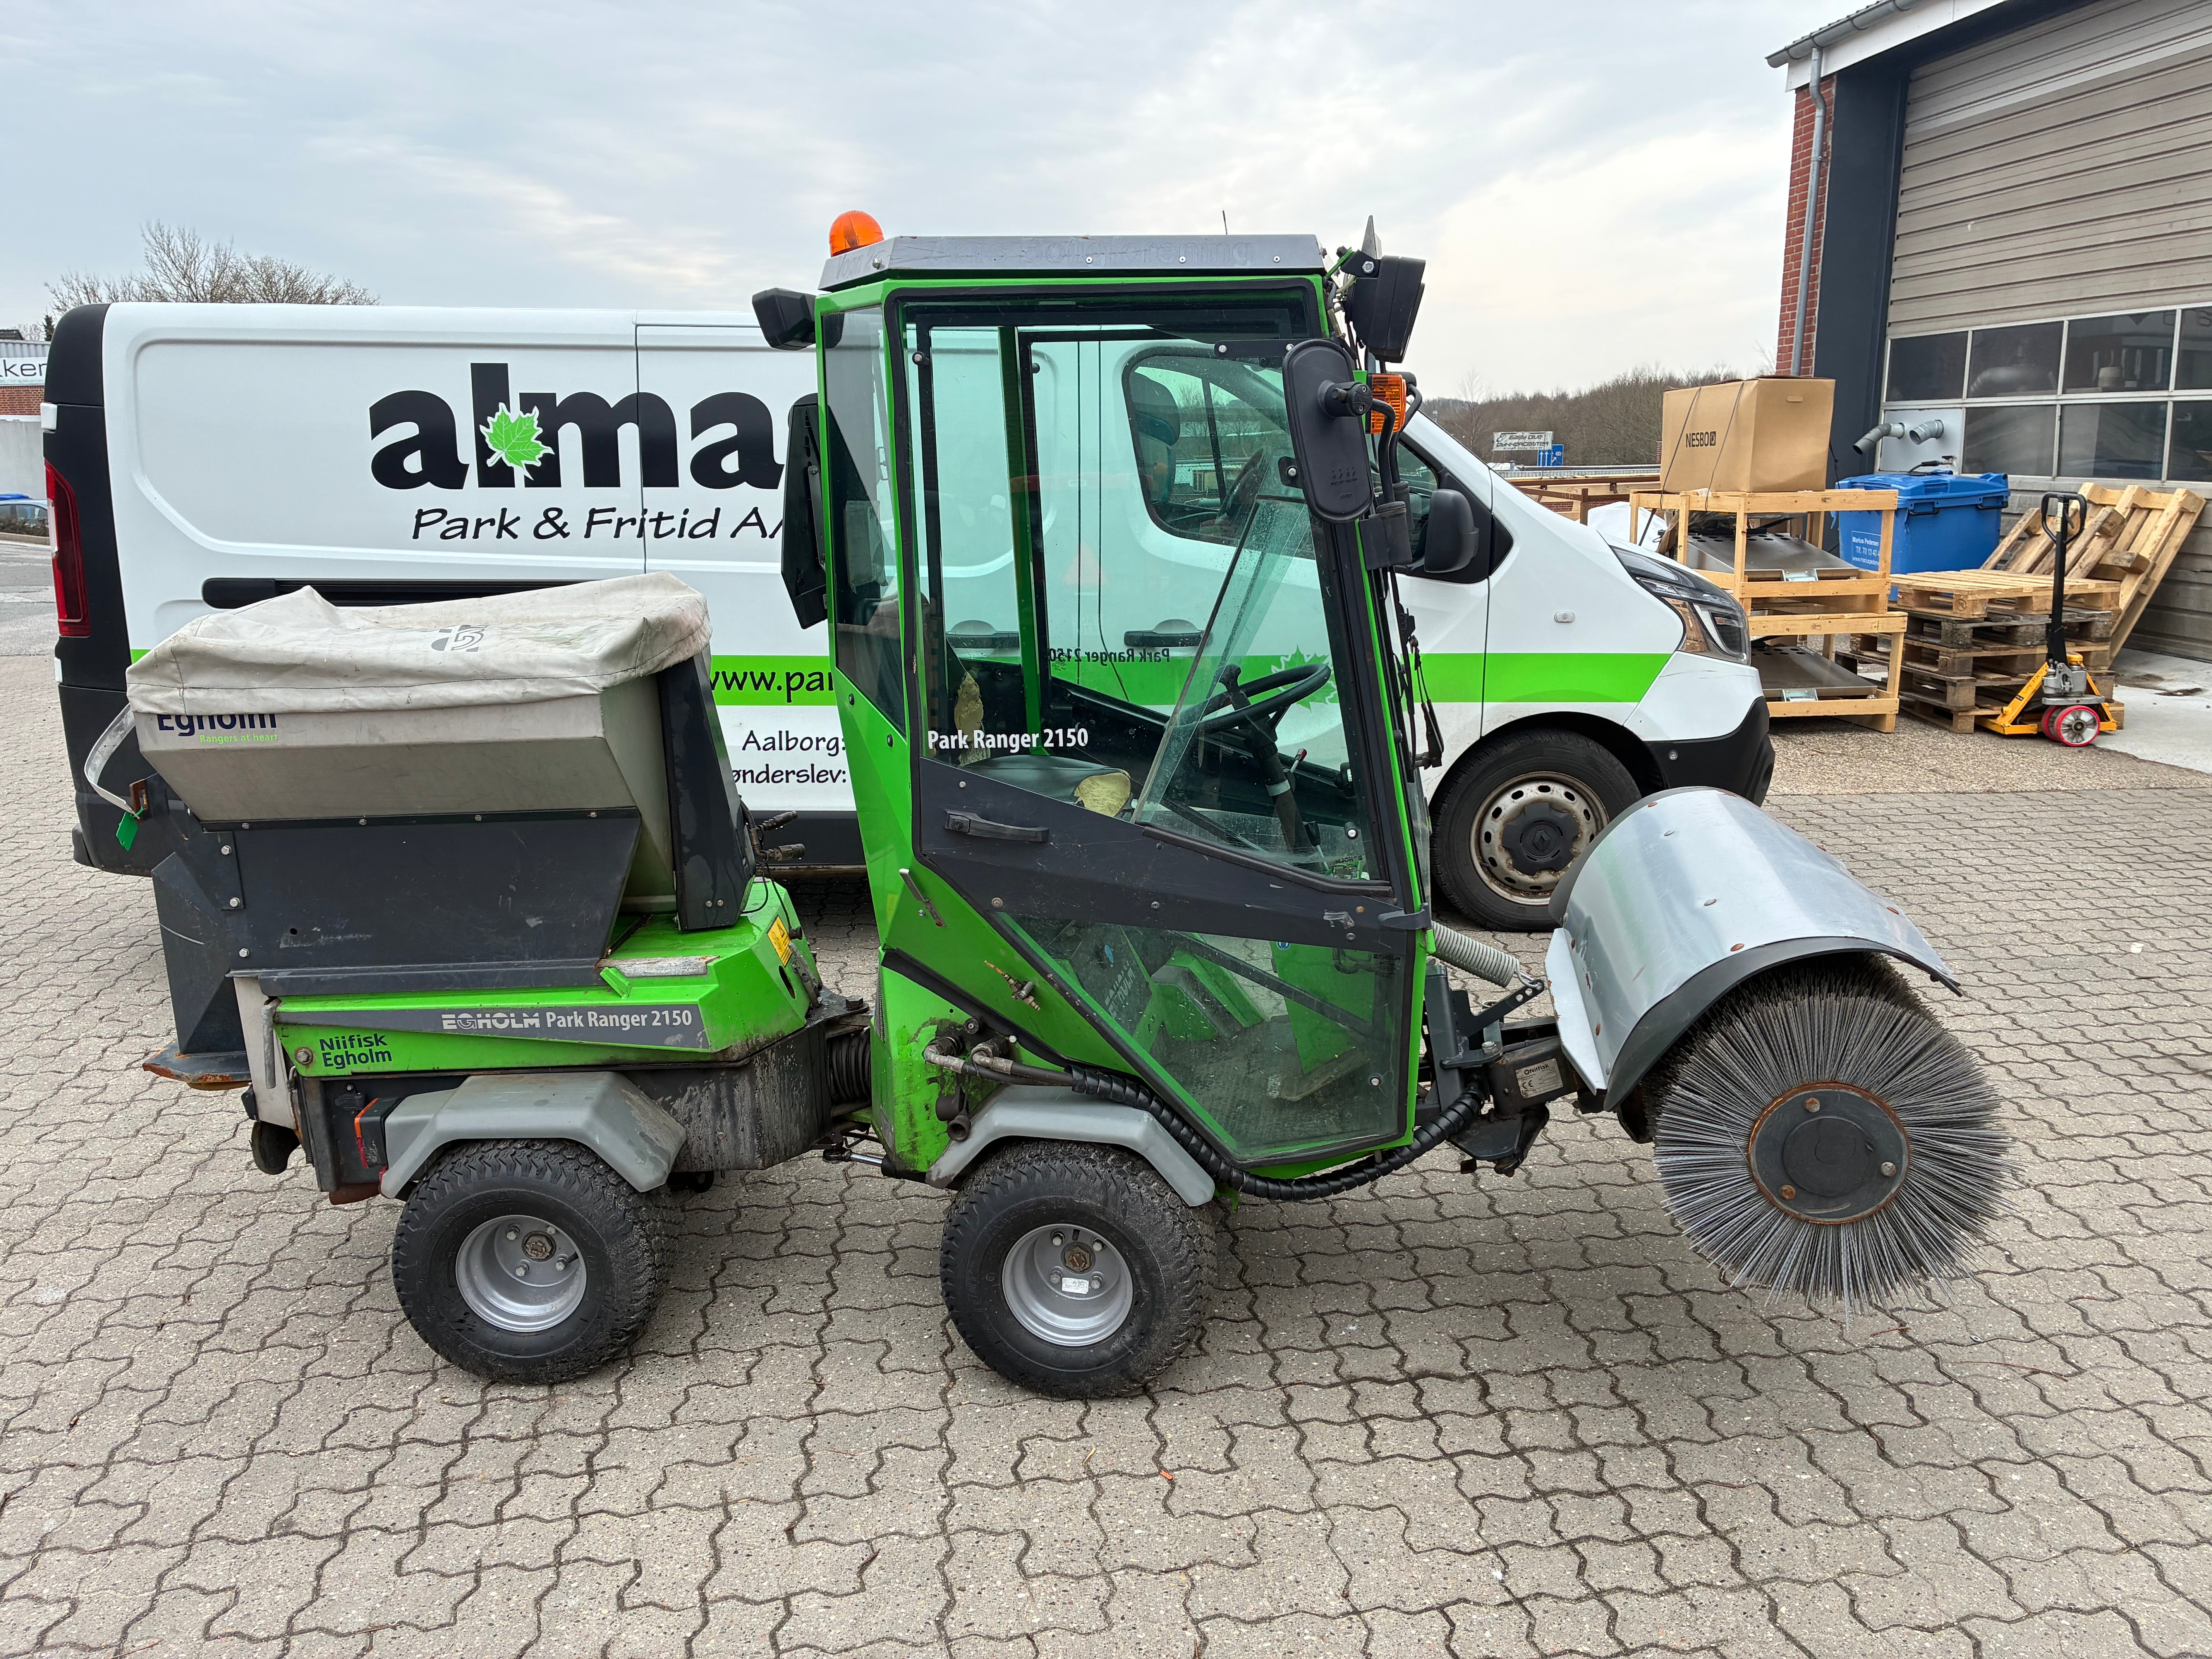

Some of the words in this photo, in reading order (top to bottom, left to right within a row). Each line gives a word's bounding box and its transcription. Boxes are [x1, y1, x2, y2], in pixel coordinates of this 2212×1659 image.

[369, 362, 818, 489] alma
[412, 507, 521, 540] Park
[533, 507, 570, 539] &
[584, 507, 721, 539] Fritid
[199, 735, 237, 744] Rangers
[742, 730, 846, 756] Aalborg:
[928, 730, 969, 749] Park
[974, 730, 1039, 753] Ranger
[1044, 728, 1089, 747] 2150
[441, 1012, 540, 1029] EGHOLM
[546, 1012, 584, 1027] Park
[588, 1010, 647, 1031] Ranger
[651, 1010, 692, 1026] 2150
[322, 1048, 392, 1070] Egholm
